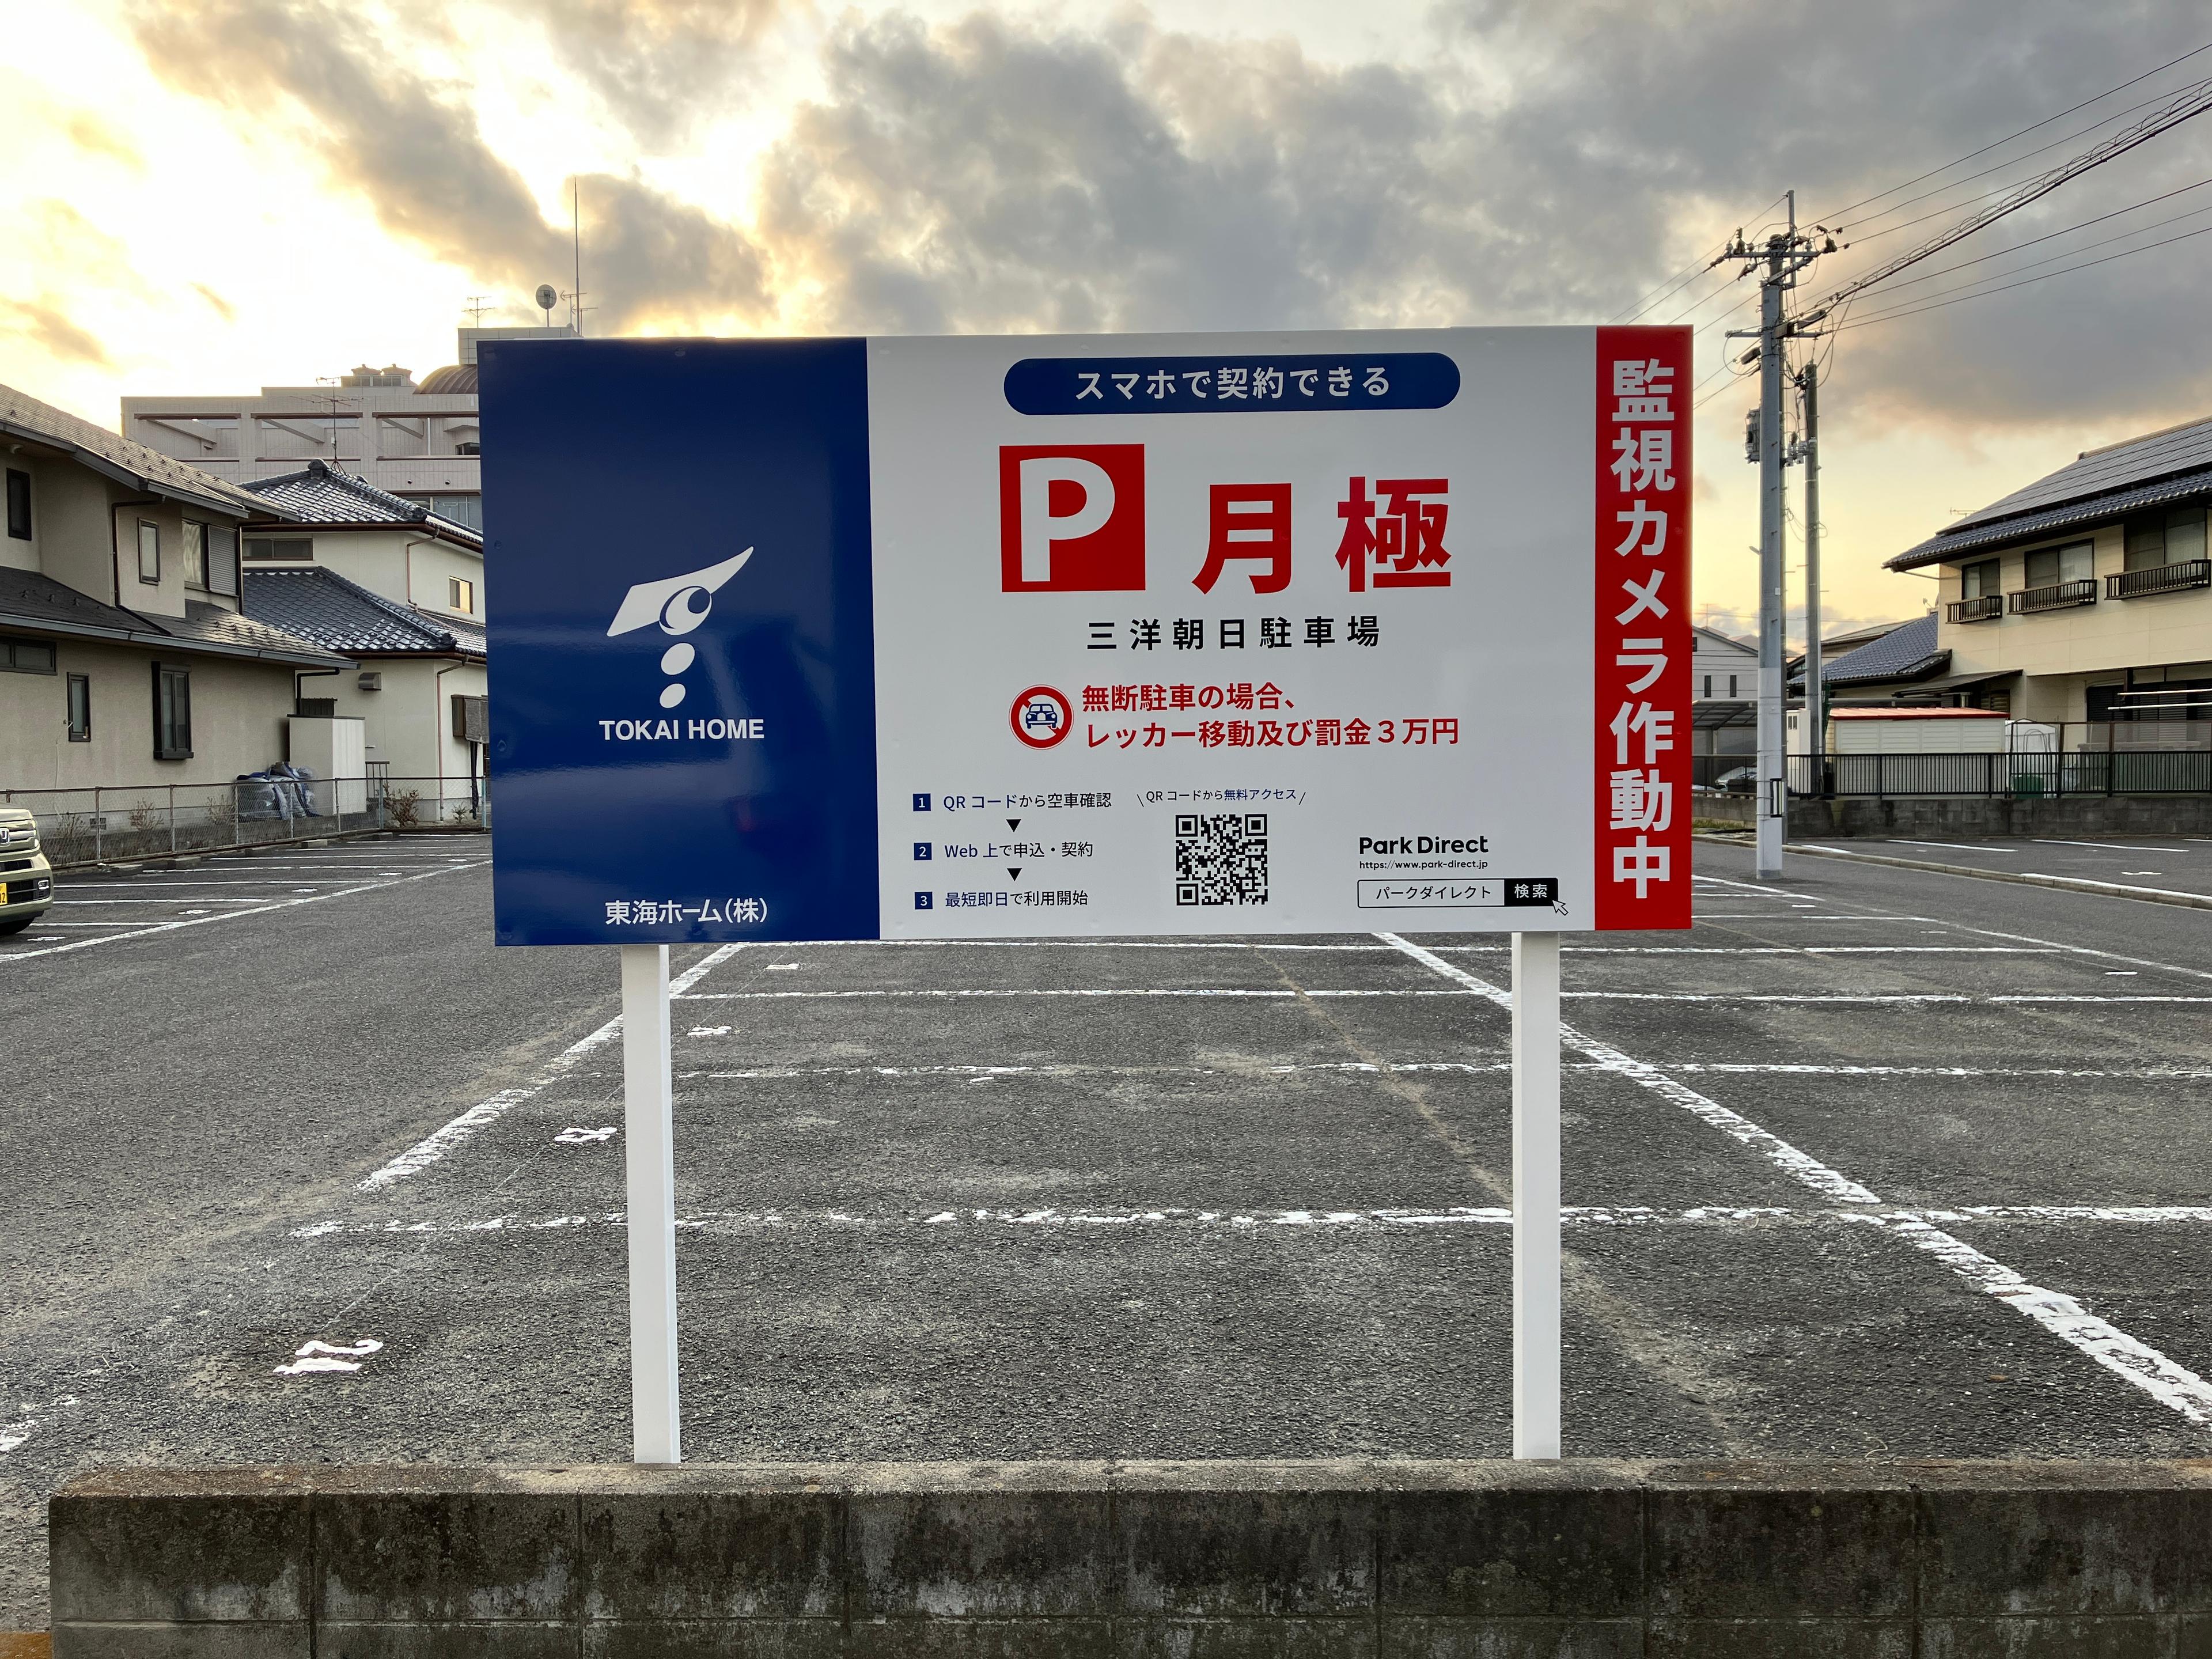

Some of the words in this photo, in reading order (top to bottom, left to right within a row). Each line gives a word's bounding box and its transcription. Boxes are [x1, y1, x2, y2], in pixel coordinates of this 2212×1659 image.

[1075, 366, 1389, 400] スマホで契約できる
[1020, 457, 1115, 582] P
[1191, 476, 1452, 595] 月極
[1087, 615, 1380, 651] 三洋朝日駐車場
[1609, 358, 1676, 899] 監視カメラ作動中
[1082, 682, 1295, 712] 無断駐車の場合、
[599, 719, 679, 740] TOKAI
[688, 719, 764, 740] HOME
[1359, 836, 1413, 855] Park
[1417, 835, 1489, 854] Direct
[1359, 859, 1488, 871] https://www.park-direct.jp
[945, 889, 1088, 908] 最短即日で利用開始
[1376, 885, 1491, 900] パークダイレクト
[1514, 883, 1547, 899] 検索
[605, 897, 767, 925] 東海ホーム(株)
